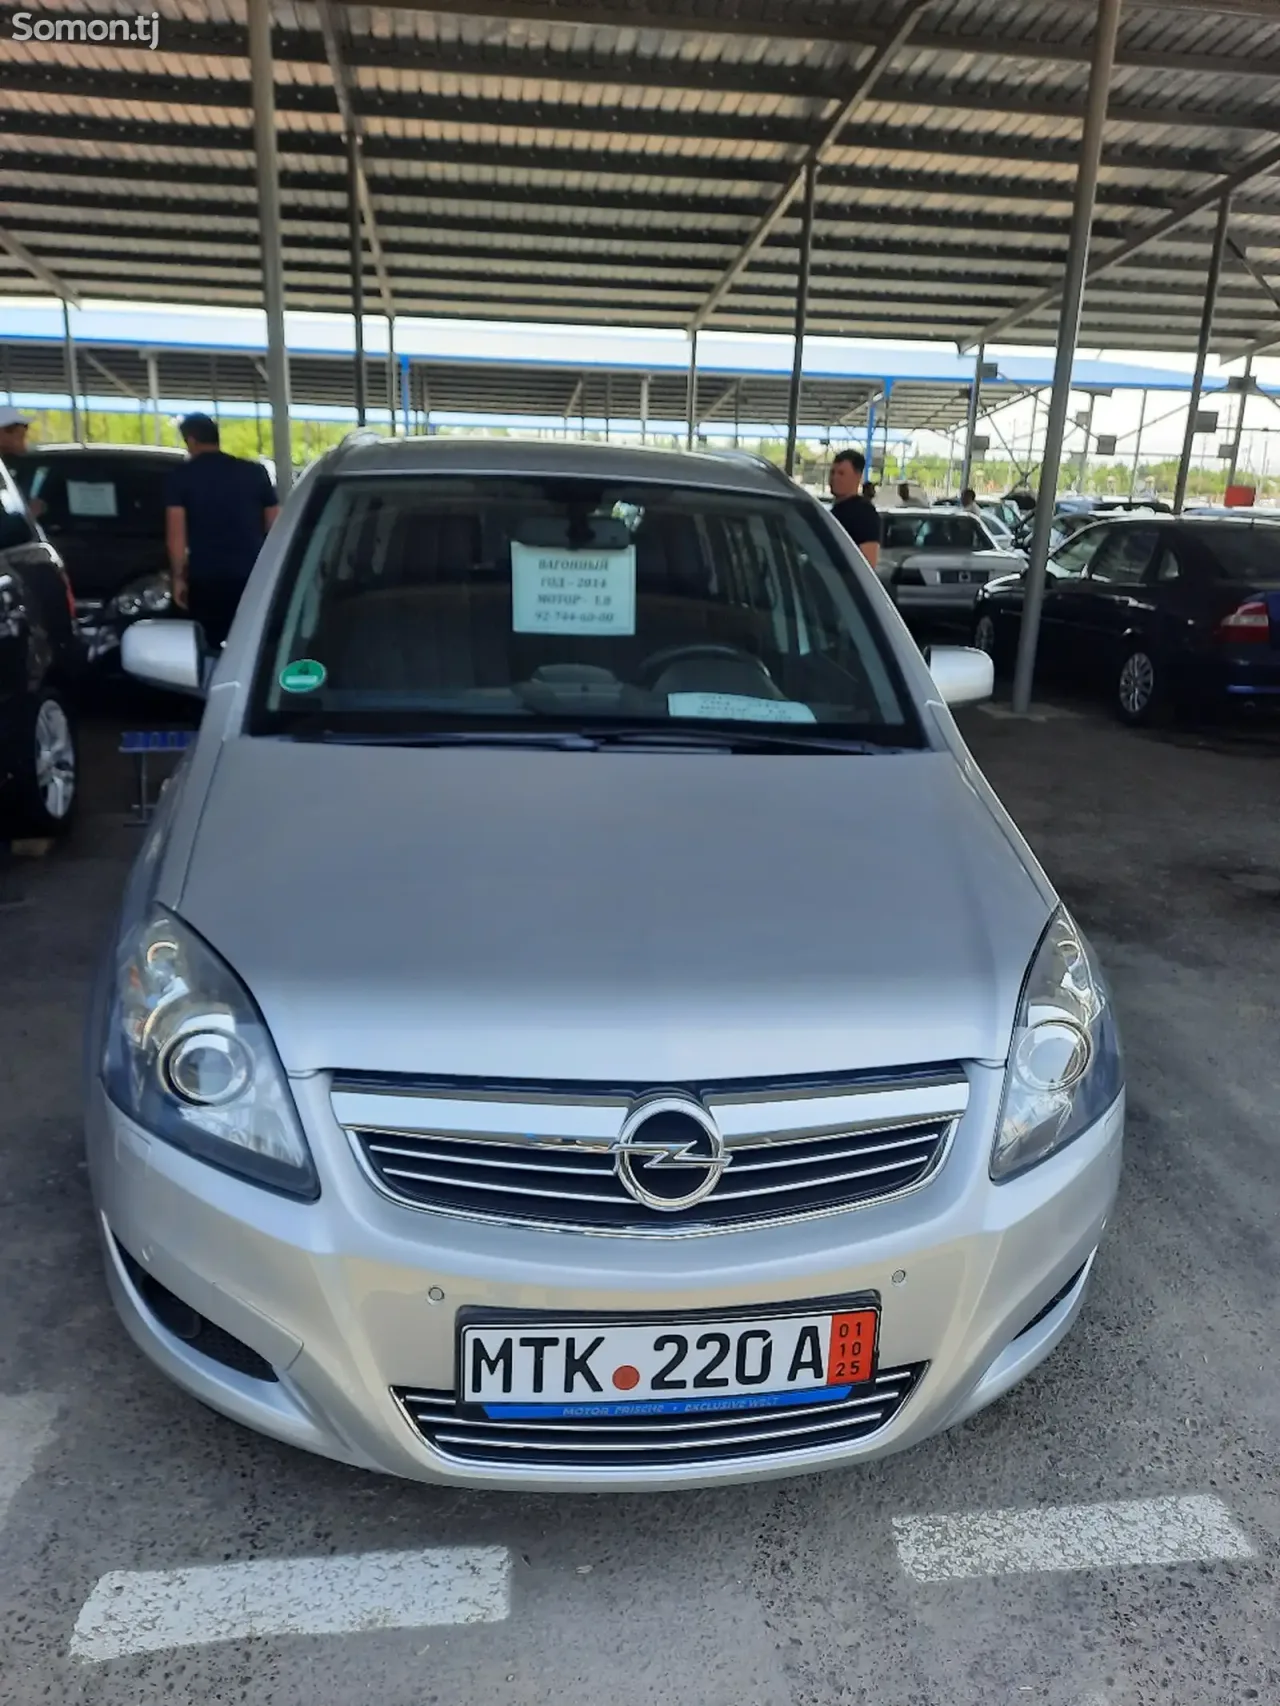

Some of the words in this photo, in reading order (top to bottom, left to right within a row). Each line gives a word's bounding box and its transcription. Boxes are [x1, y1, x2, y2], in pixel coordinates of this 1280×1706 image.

[839, 1321, 863, 1338] 01
[839, 1341, 862, 1357] 10
[471, 1336, 605, 1394] MTK
[650, 1329, 773, 1391] 220
[787, 1325, 825, 1382] A
[835, 1360, 861, 1377] 25
[562, 1406, 610, 1416] MOTOR
[684, 1399, 746, 1412] EXCLUSIVE
